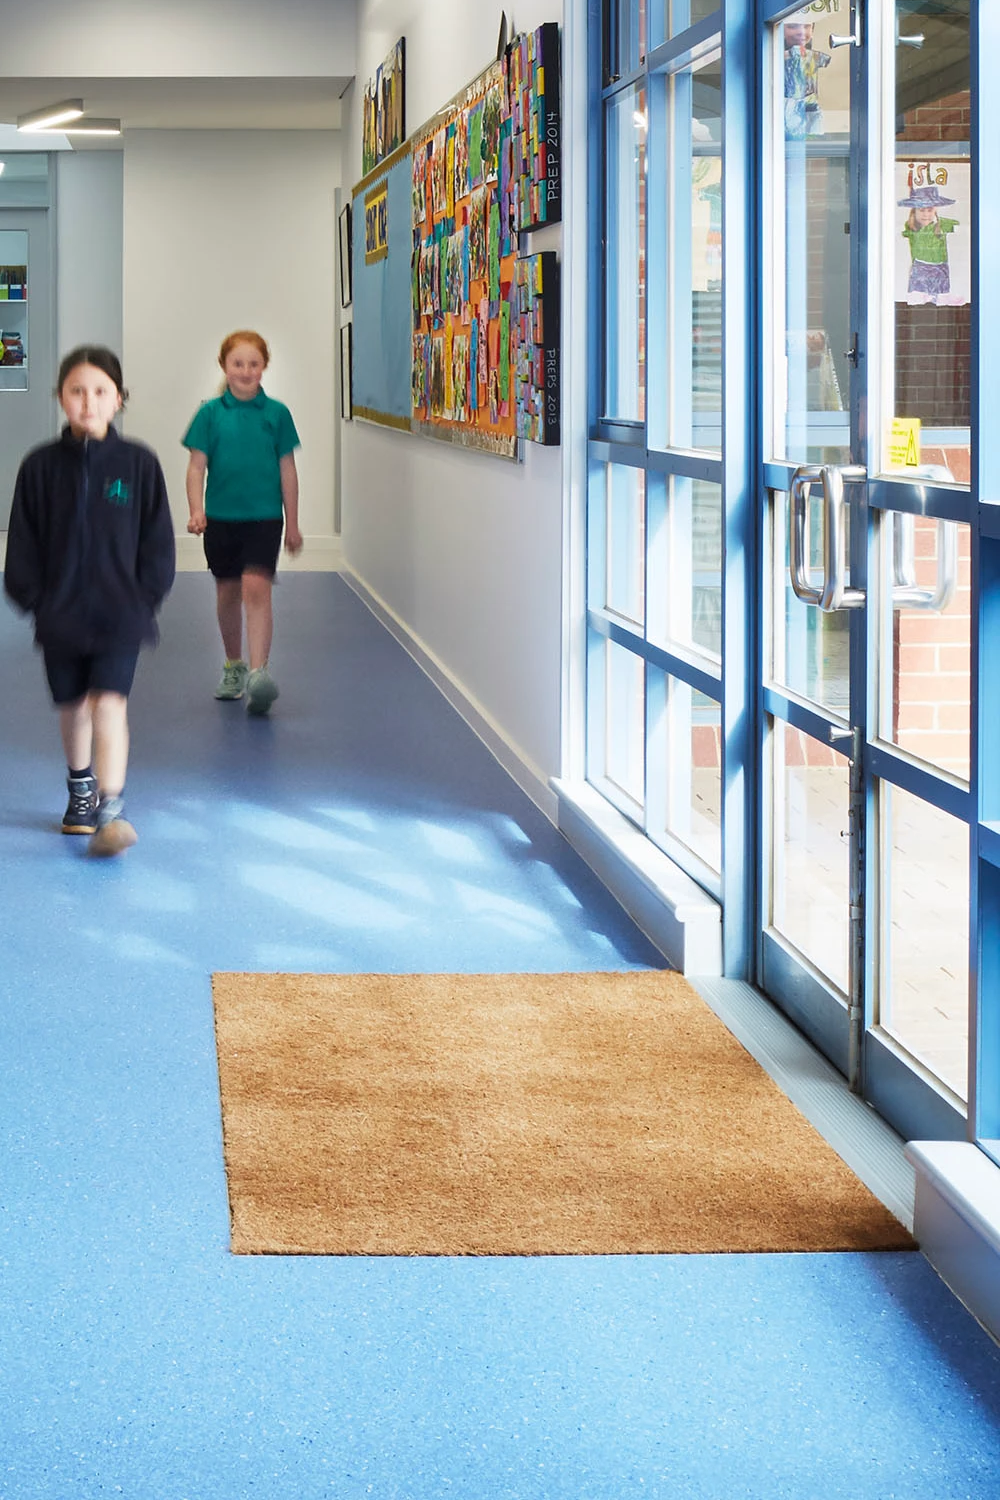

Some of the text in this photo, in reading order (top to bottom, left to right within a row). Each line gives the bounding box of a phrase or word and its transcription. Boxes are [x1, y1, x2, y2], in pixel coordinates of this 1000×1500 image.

[546, 111, 559, 202] PREP 2014
[546, 347, 557, 425] PREPS 2013
